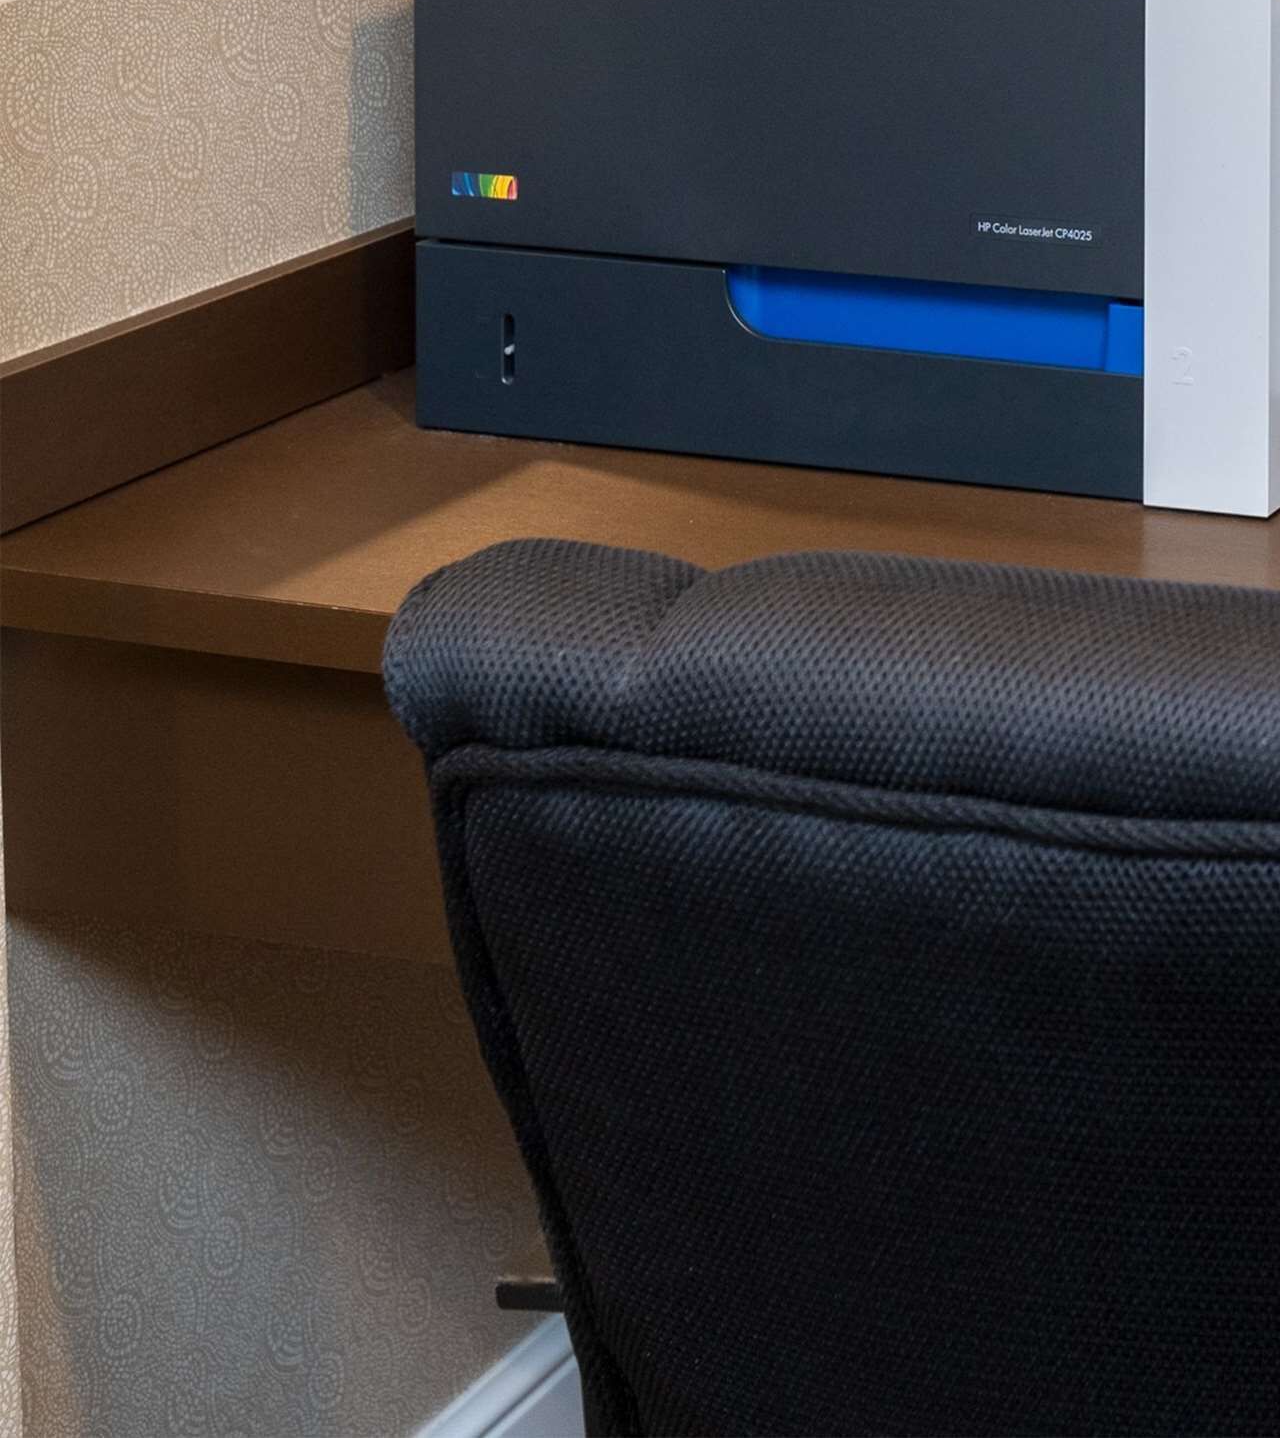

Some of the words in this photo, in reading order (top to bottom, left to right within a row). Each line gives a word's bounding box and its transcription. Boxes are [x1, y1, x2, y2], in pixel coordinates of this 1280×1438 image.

[977, 221, 991, 232] HP
[992, 222, 1017, 235] Color
[1018, 224, 1054, 238] LaserJet
[1054, 227, 1093, 241] CP4025
